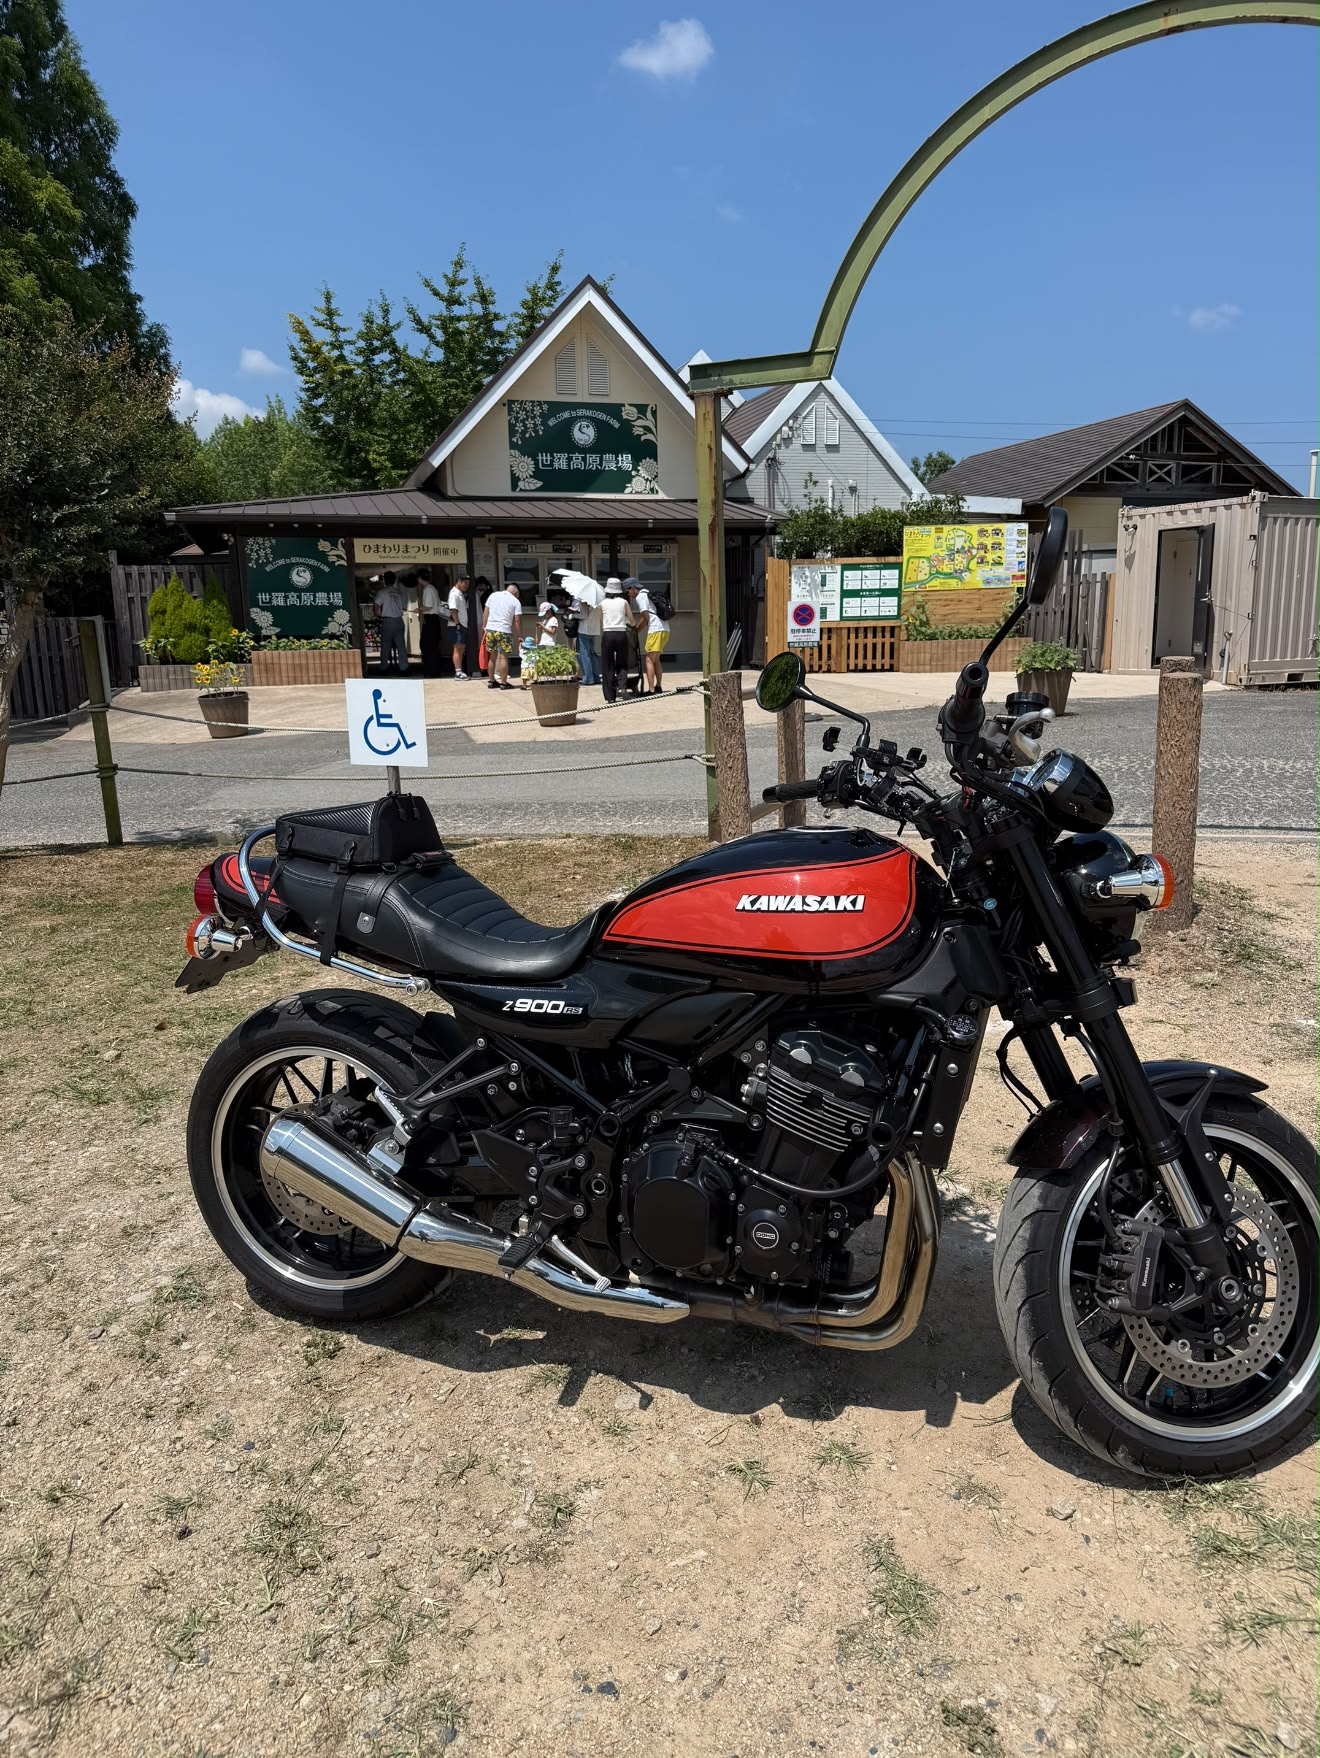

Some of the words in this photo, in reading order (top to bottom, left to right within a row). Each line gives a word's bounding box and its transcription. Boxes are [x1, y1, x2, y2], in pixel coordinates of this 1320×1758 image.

[547, 410, 572, 427] WELCOME
[576, 409, 607, 421] SERAKOGEN
[606, 415, 621, 429] FARM
[536, 452, 633, 471] 世羅高原農場
[362, 544, 430, 555] ひまわりまつり
[433, 547, 459, 556] 開催中
[264, 558, 285, 572] WELCOME
[317, 561, 331, 573] FARM
[256, 592, 344, 607] 世羅高原農場
[735, 894, 866, 912] KAWASAKI
[1141, 1256, 1151, 1287] Kawasaki
